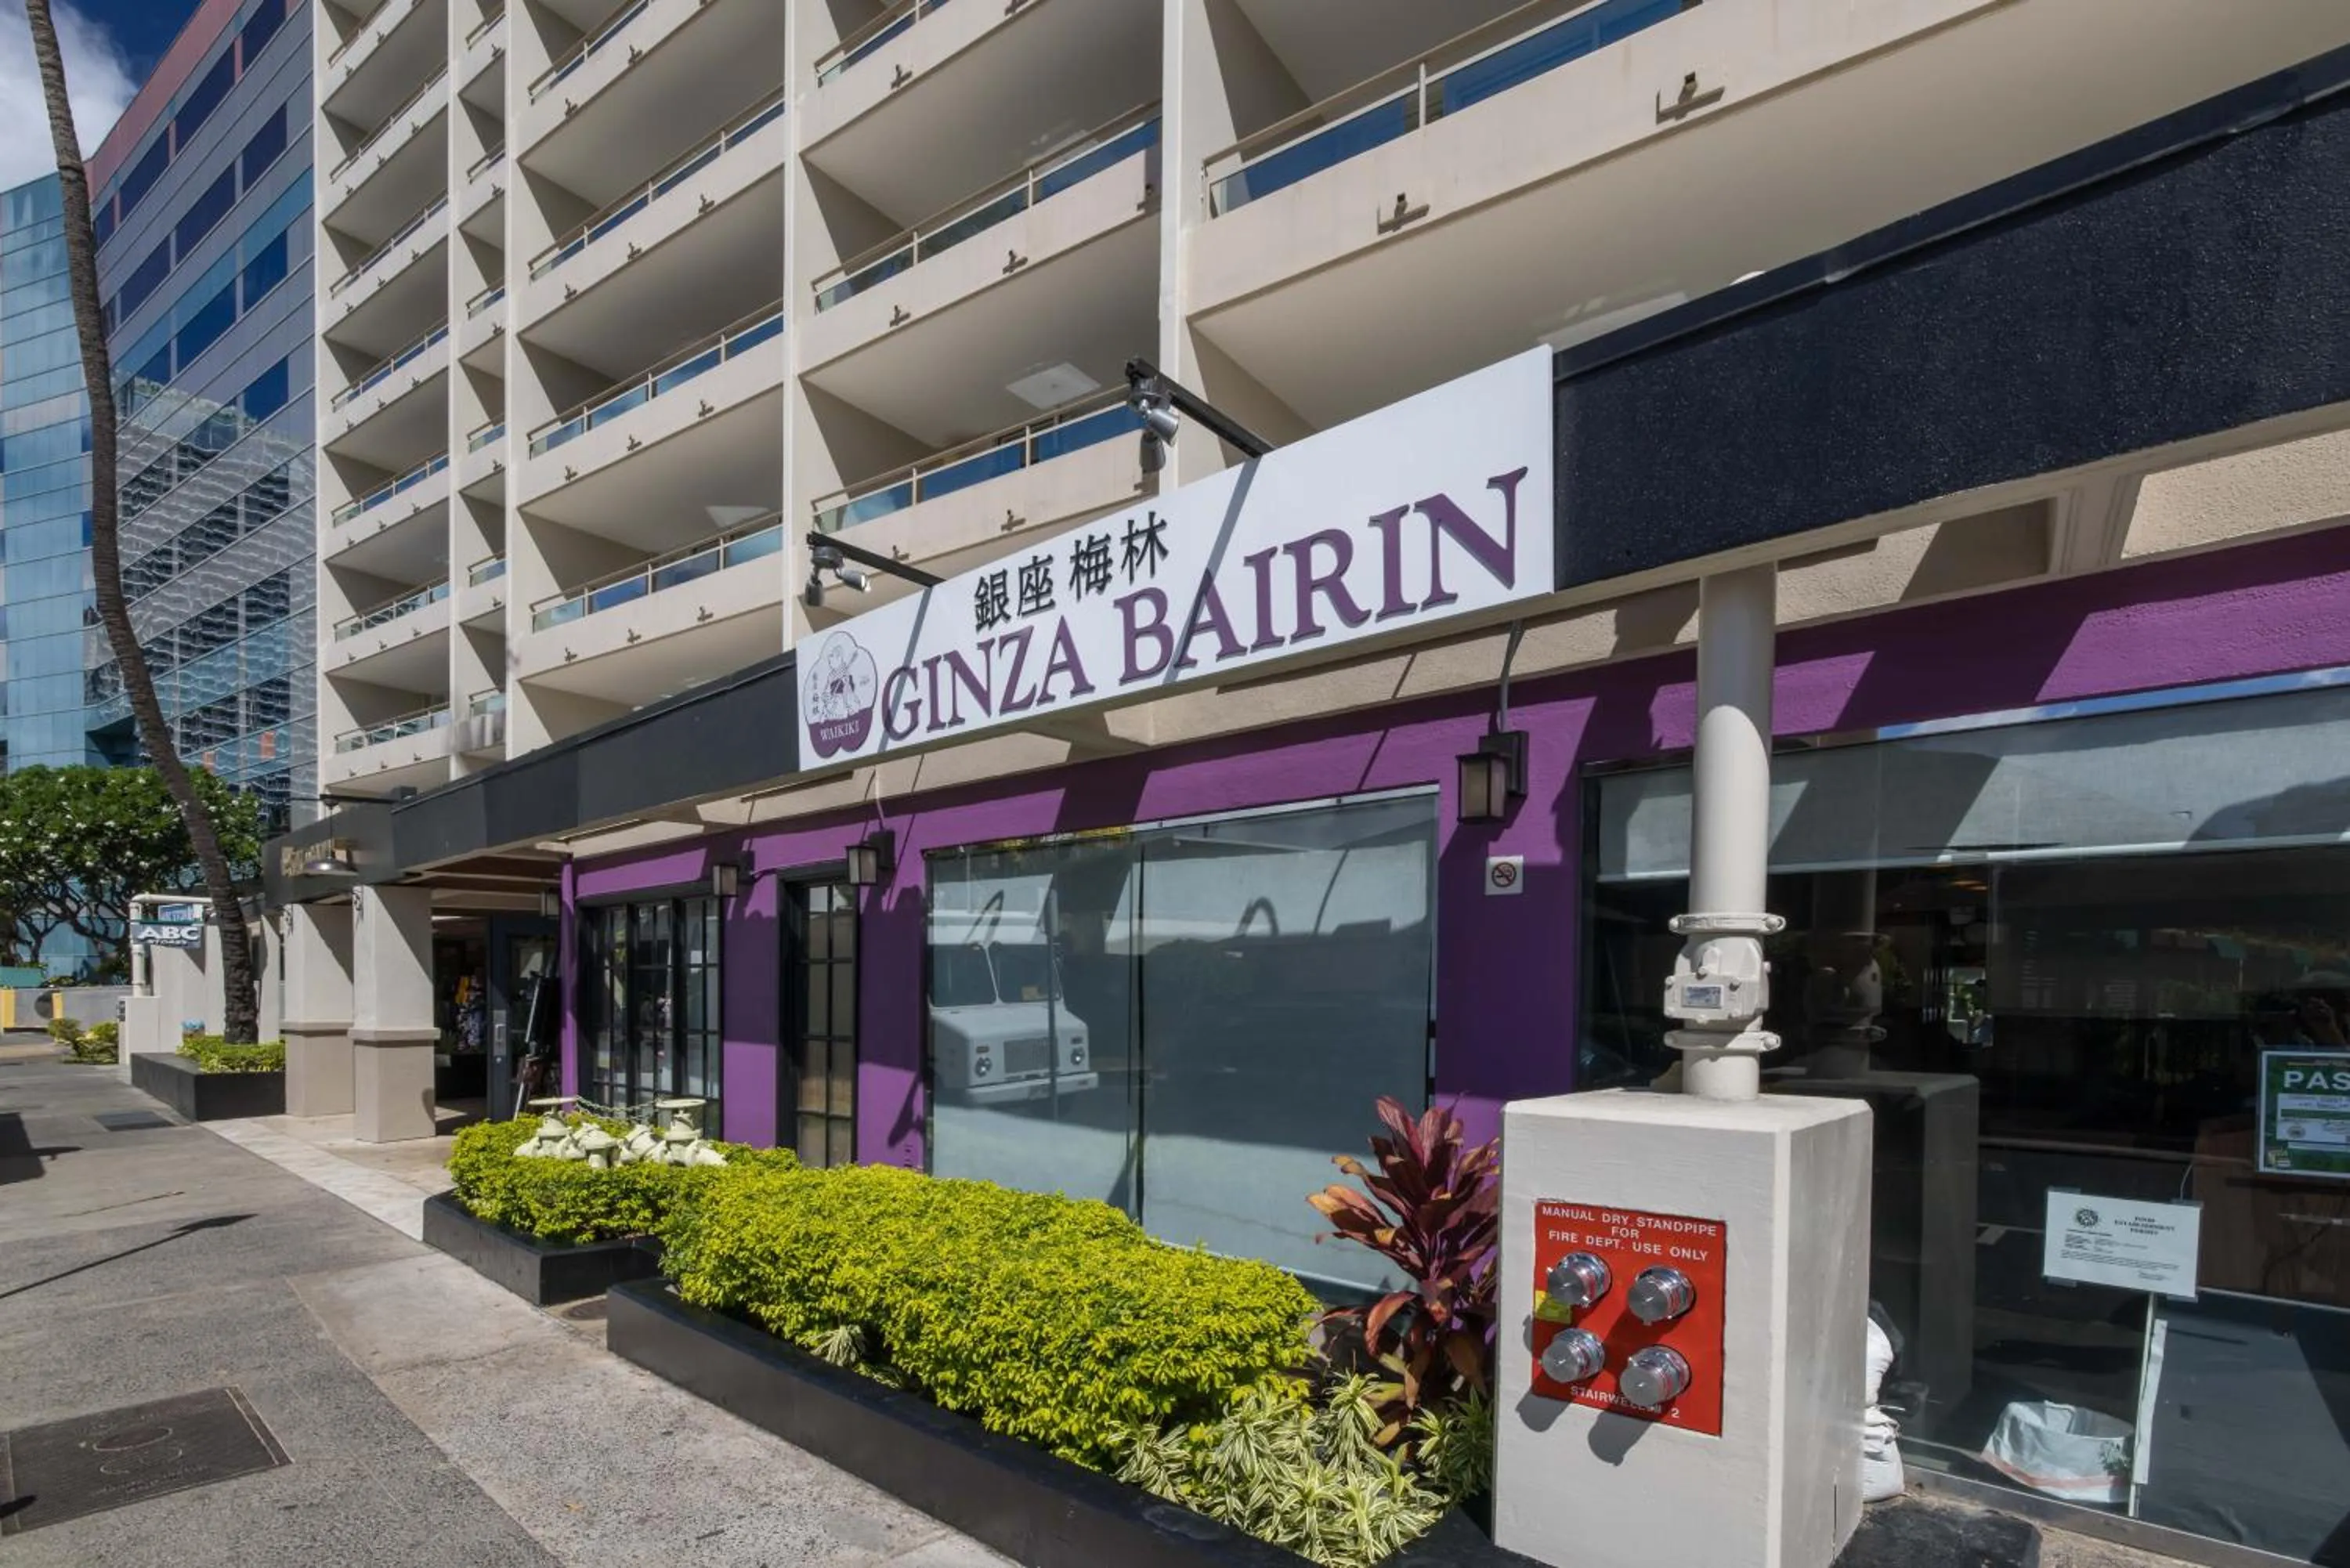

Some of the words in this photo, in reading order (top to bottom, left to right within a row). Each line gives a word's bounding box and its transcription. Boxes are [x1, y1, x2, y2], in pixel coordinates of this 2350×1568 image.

[974, 510, 1170, 633] 銀座梅林
[881, 615, 1096, 742] GINZA
[1113, 466, 1528, 686] BAIRIN
[820, 719, 860, 741] WAIKIKI
[137, 925, 199, 941] ABC
[1542, 1205, 1596, 1222] MANUAL
[1601, 1213, 1629, 1227] DRY
[1636, 1216, 1717, 1237] STANDPIPE
[1611, 1226, 1640, 1240] FOR
[1548, 1230, 1578, 1244] FIRE
[1585, 1235, 1626, 1250] DEPT.
[1632, 1241, 1662, 1255] USE
[1669, 1246, 1709, 1262] ONLY
[1671, 1407, 1680, 1418] 2
